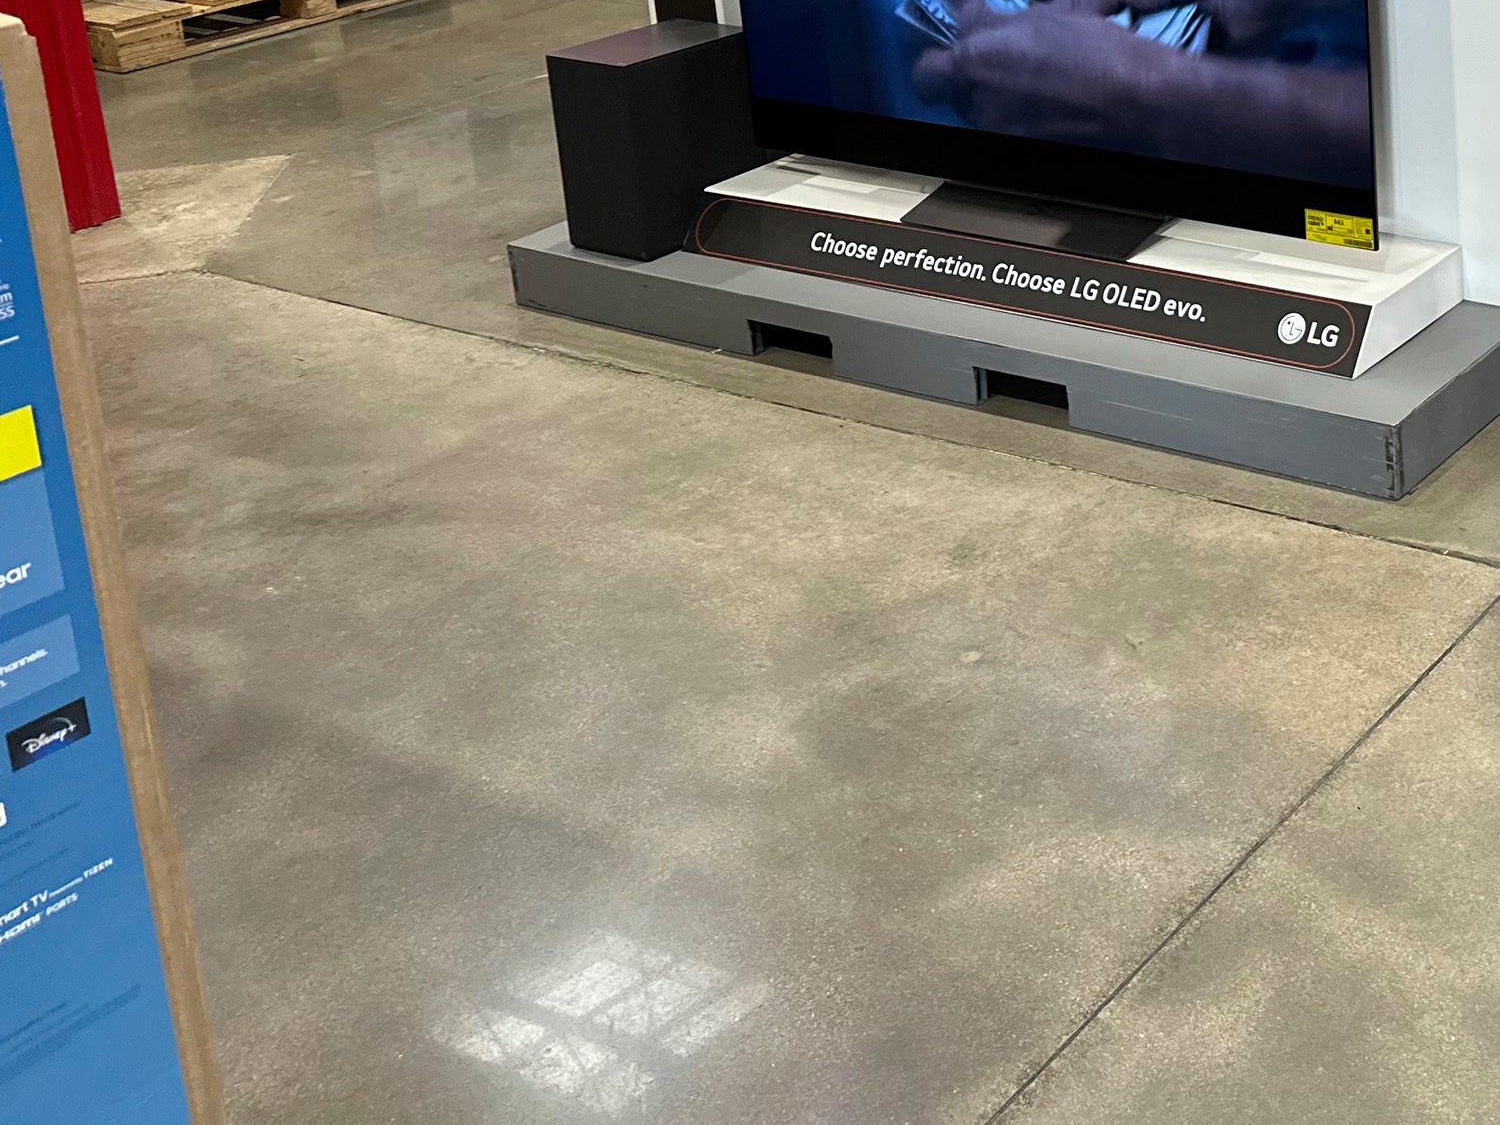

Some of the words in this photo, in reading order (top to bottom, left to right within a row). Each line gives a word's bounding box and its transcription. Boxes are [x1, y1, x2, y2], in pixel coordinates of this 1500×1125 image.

[811, 231, 878, 261] Choose
[880, 248, 987, 282] perfection.
[991, 263, 1066, 295] Choose
[1070, 277, 1101, 302] LG
[1102, 283, 1161, 312] OLED
[1163, 298, 1206, 323] evo.
[1306, 321, 1341, 348] LG
[21, 717, 77, 754] Disney+
[30, 890, 48, 907] TV
[83, 858, 113, 879] TIZEN
[46, 892, 79, 916] PORTS
